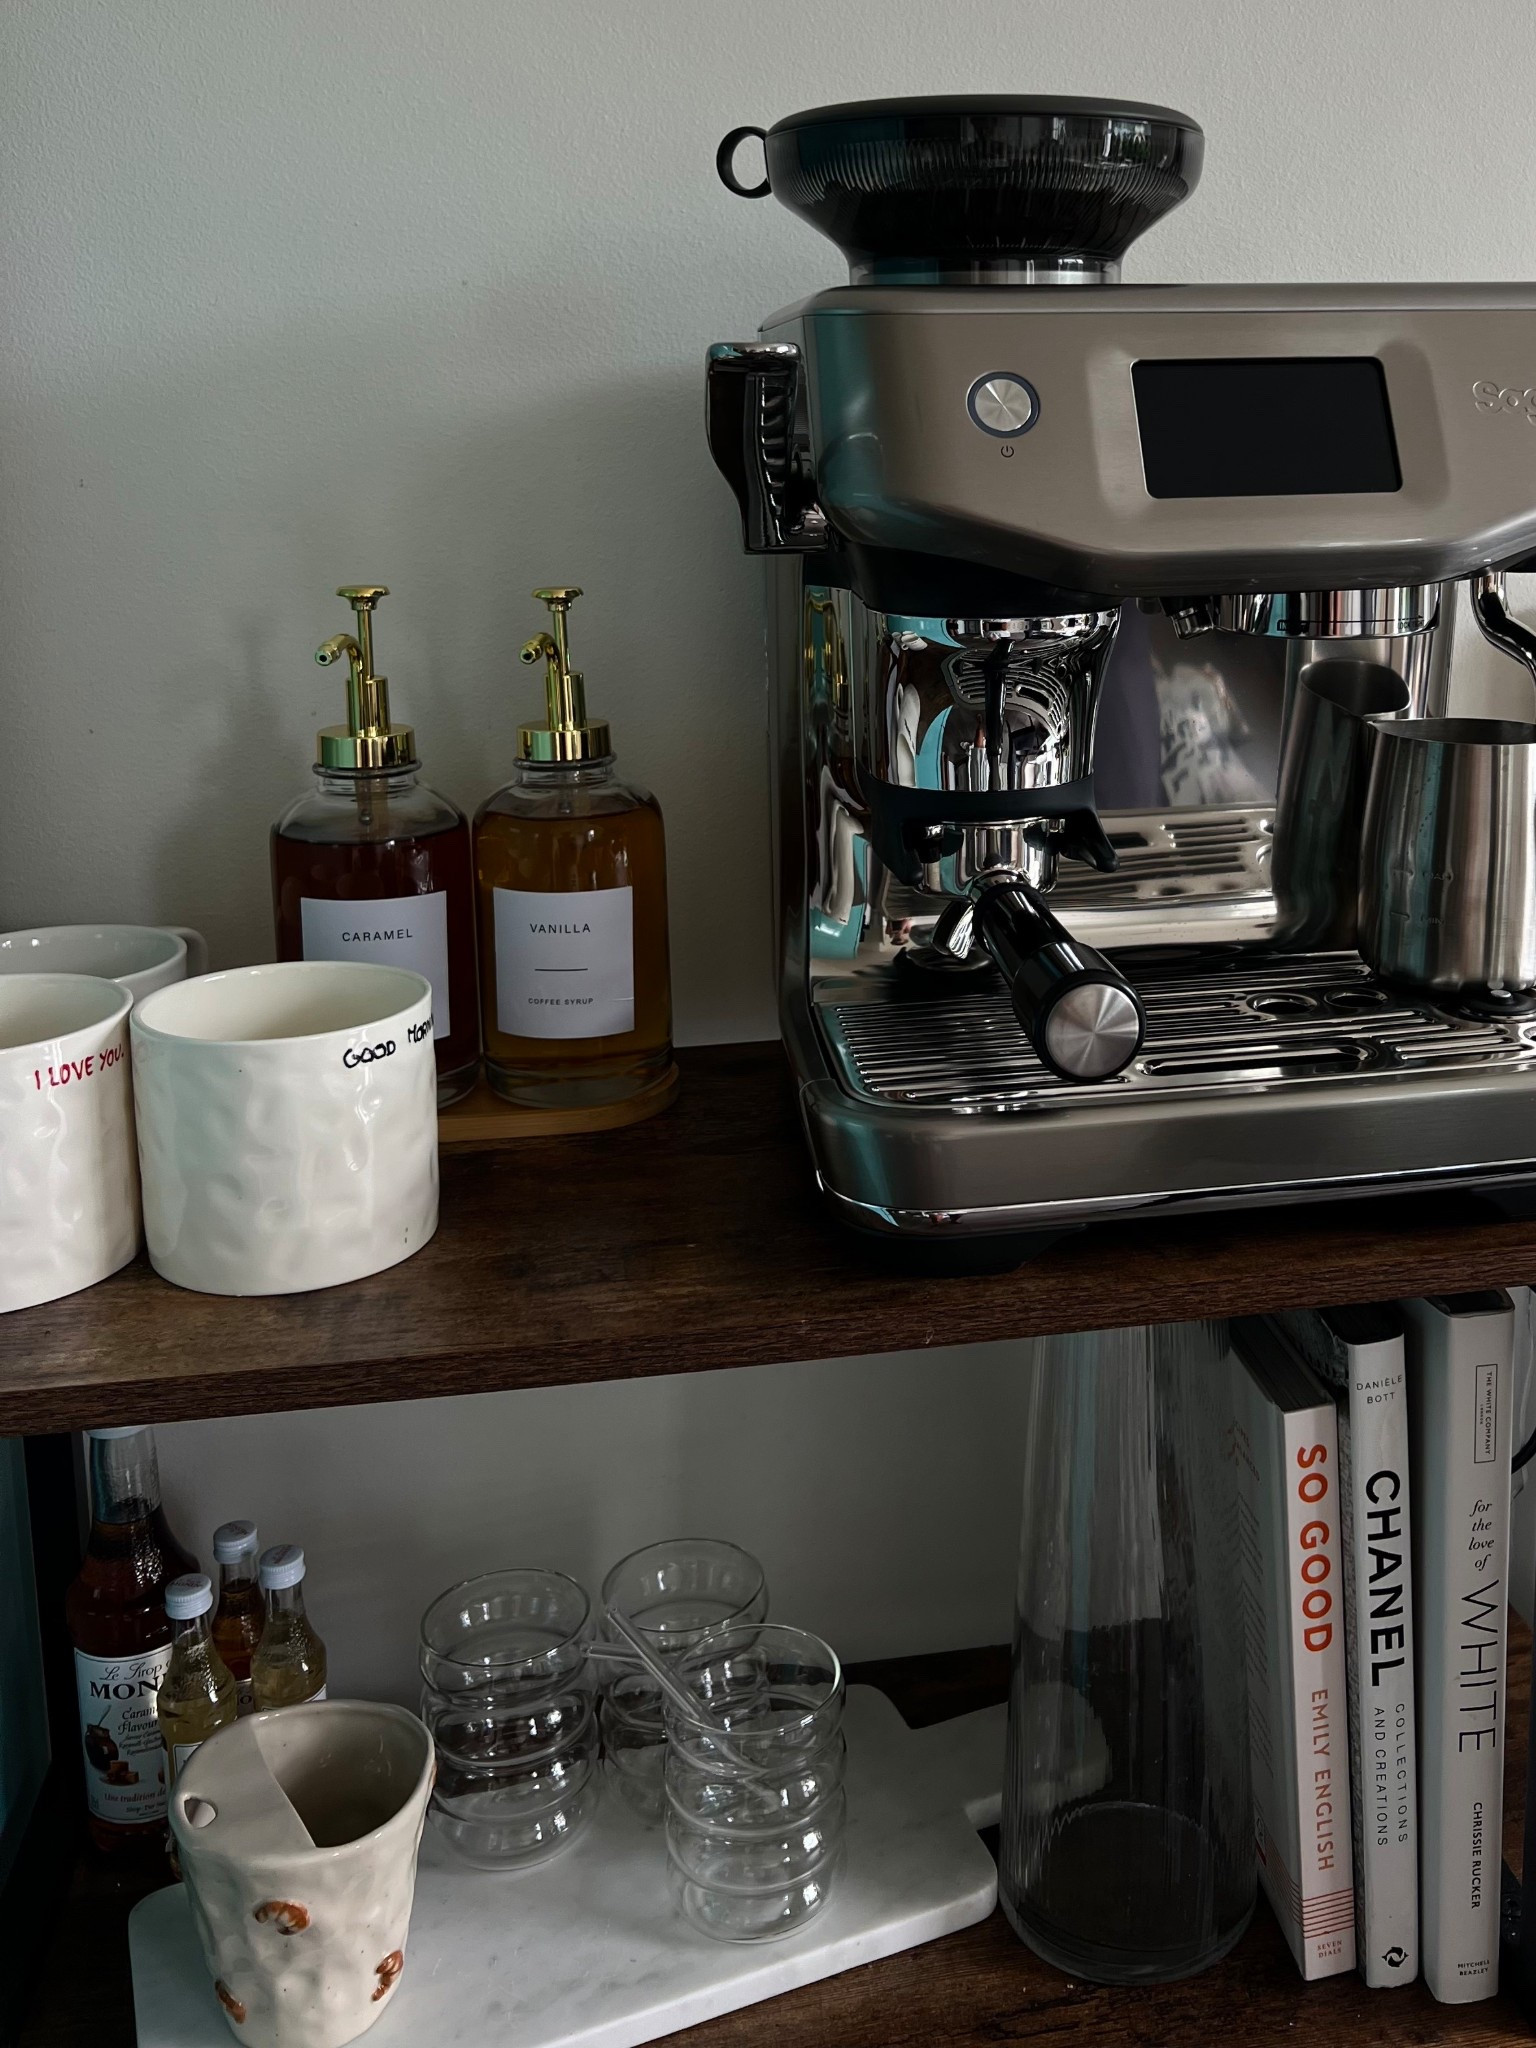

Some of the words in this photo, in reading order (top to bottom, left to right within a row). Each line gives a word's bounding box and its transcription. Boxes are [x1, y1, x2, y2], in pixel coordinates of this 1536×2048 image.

[342, 928, 413, 942] CARAMEL
[529, 923, 591, 934] VANILLA
[528, 997, 561, 1006] COFFEE
[564, 997, 594, 1006] SYRUP
[343, 1040, 396, 1069] GOOD
[34, 1069, 41, 1090] I
[48, 1055, 95, 1087] LOVE
[1356, 1374, 1404, 1392] DANIÈLE
[1366, 1391, 1396, 1404] BOTT
[1484, 1417, 1492, 1455] COMPANY
[1297, 1443, 1328, 1504] SO
[1469, 1499, 1493, 1517] for
[1471, 1519, 1493, 1532] the
[1468, 1536, 1495, 1552] love
[1474, 1553, 1491, 1572] of
[1299, 1520, 1333, 1653] GOOD
[1366, 1470, 1405, 1688] CHANEL
[99, 1665, 120, 1681] Le
[1459, 1578, 1499, 1753] WHITE
[1312, 1688, 1331, 1757] EMILY
[1374, 1707, 1386, 1742] AND
[1395, 1703, 1409, 1843] COLLECTIONS
[1375, 1749, 1388, 1846] CREATIONS
[1315, 1768, 1335, 1872] ENGLISH
[1471, 1801, 1483, 1857] CHRISSIE
[1471, 1859, 1483, 1910] RUCKER
[1317, 1940, 1343, 1951] SEVEN
[1318, 1947, 1342, 1958] DIALS
[1457, 1958, 1490, 1969] MITCHELL
[1459, 1966, 1489, 1976] BEAZLEY
